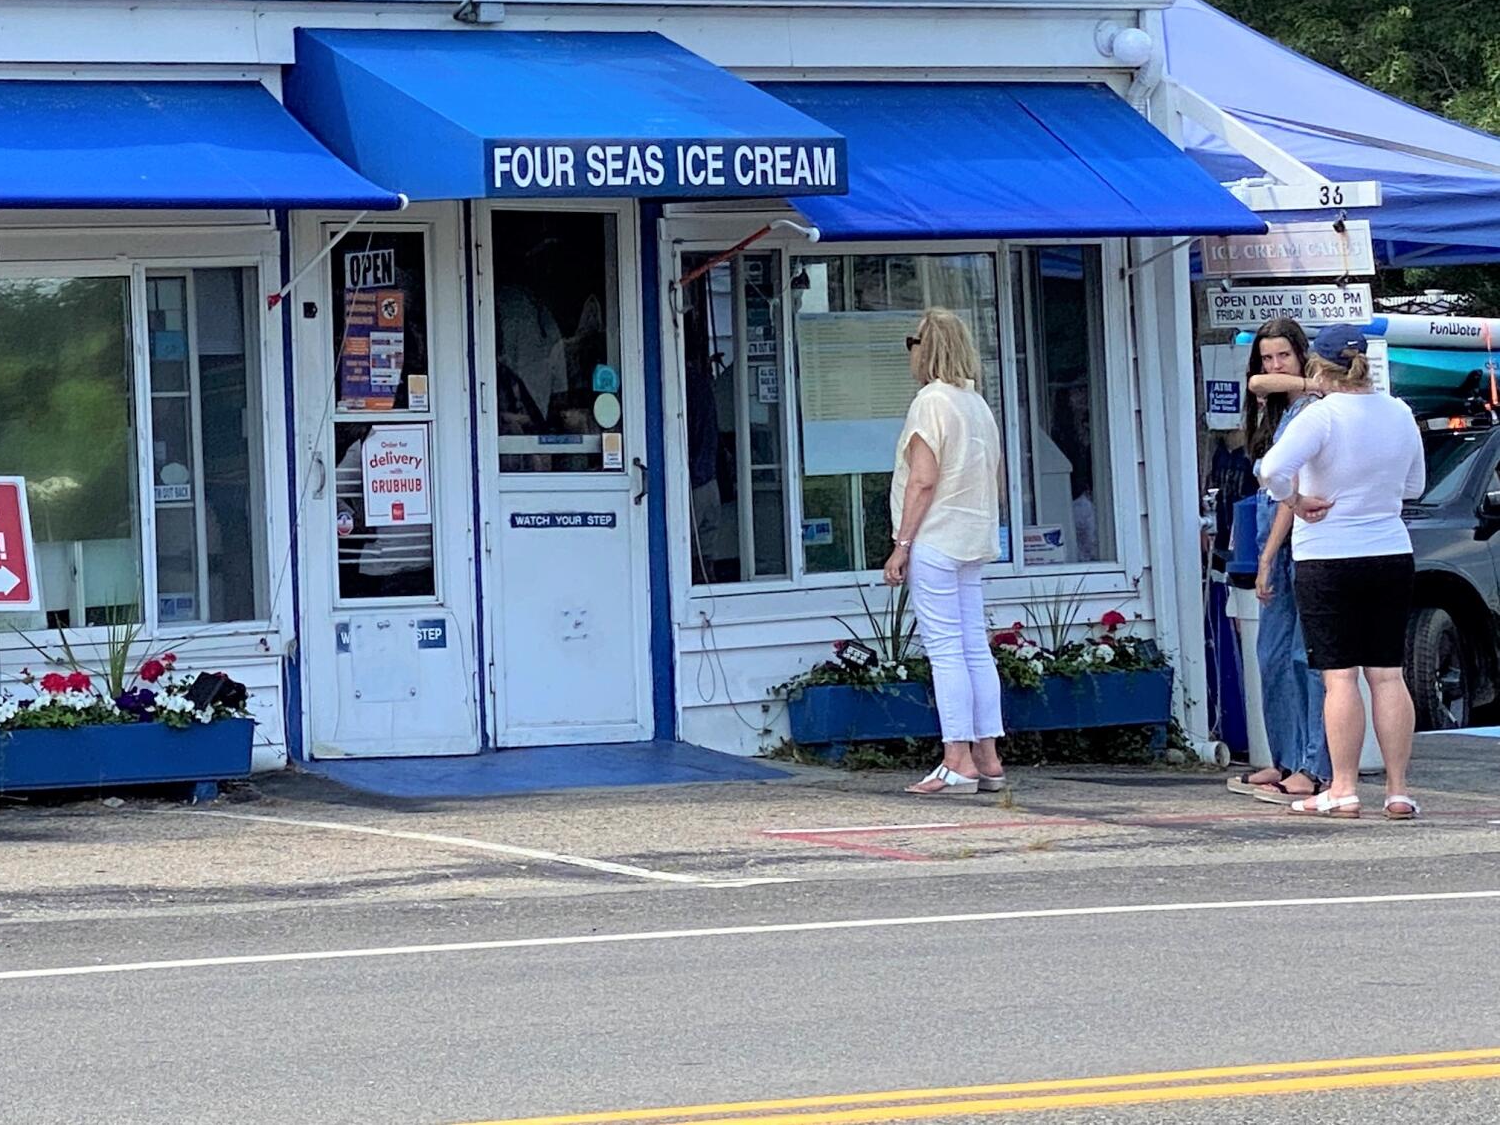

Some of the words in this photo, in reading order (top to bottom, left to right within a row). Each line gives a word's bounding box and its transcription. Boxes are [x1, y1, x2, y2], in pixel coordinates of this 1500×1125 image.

[493, 146, 576, 188] FOUR
[586, 145, 665, 187] SEAS
[677, 145, 725, 185] ICE
[734, 146, 837, 186] CREAM
[1211, 245, 1238, 260] ICE
[1243, 244, 1301, 259] CREAM
[350, 251, 394, 287] OPEN
[1215, 296, 1246, 308] OPEN
[1252, 294, 1284, 306] DAILY
[1308, 293, 1336, 305] 9:30
[1343, 293, 1361, 304] PM
[1216, 309, 1244, 320] FRIDAY
[1250, 309, 1256, 319] &
[1259, 308, 1303, 319] SATURDAY
[1321, 307, 1345, 318] 10:30
[1350, 306, 1363, 317] PM
[1214, 382, 1232, 392] ATM
[369, 451, 423, 469] delivery
[371, 478, 423, 494] GRUBHUB
[515, 515, 550, 526] WATCH
[555, 515, 582, 525] YOUR
[587, 515, 613, 525] STEP
[417, 628, 442, 642] STEP
